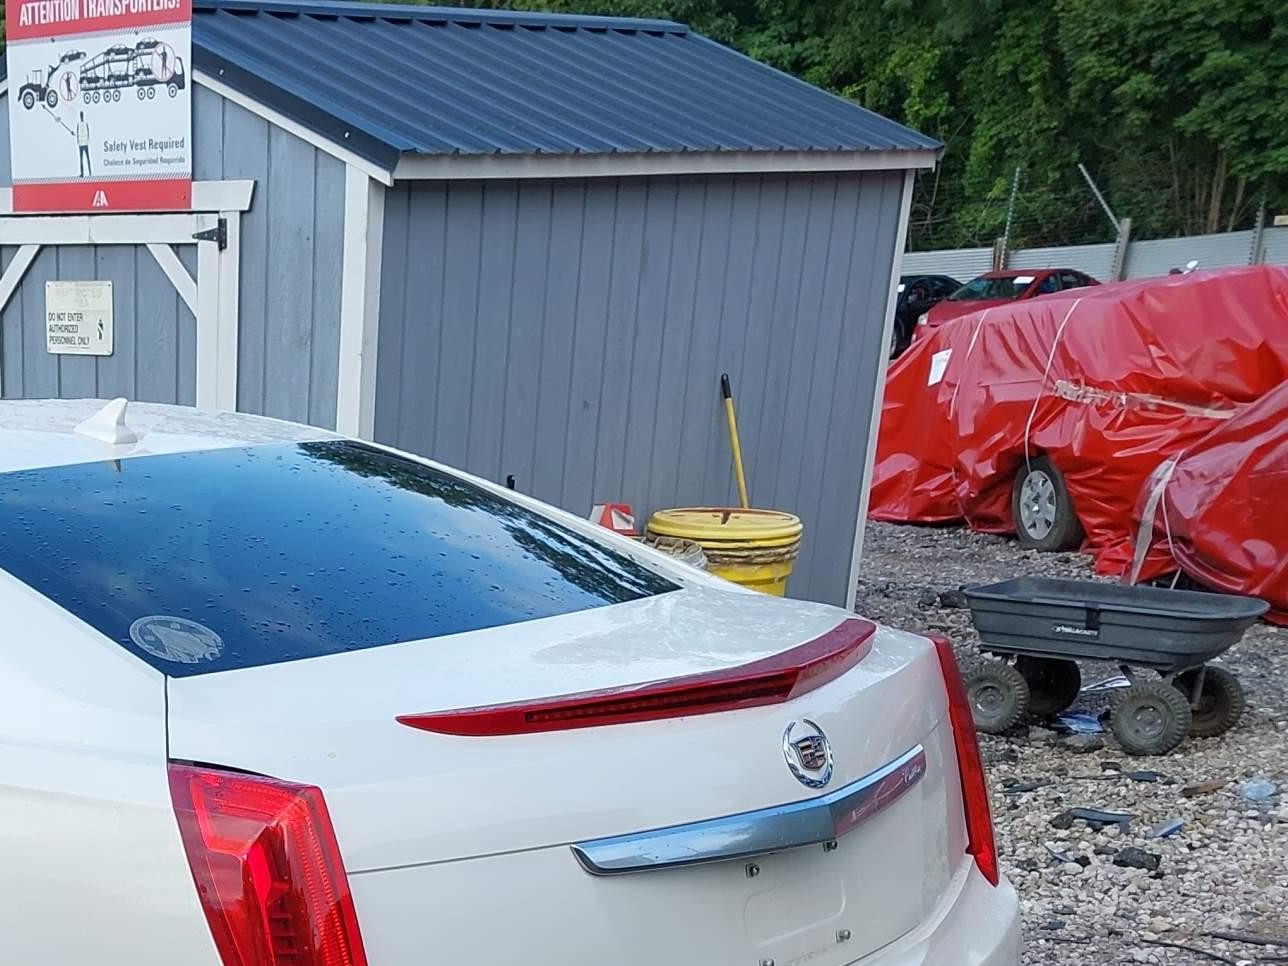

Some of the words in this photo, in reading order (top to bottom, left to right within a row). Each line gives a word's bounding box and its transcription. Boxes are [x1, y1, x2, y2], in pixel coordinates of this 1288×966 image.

[19, 0, 80, 27] ATTENTION
[103, 140, 128, 153] Safety
[129, 139, 147, 151] Vest
[148, 137, 185, 152] Required
[48, 312, 55, 321] DO
[56, 312, 66, 321] NOT
[67, 312, 83, 322] ENTER
[49, 324, 79, 333] AUTHORIZED
[77, 336, 90, 346] ONLY
